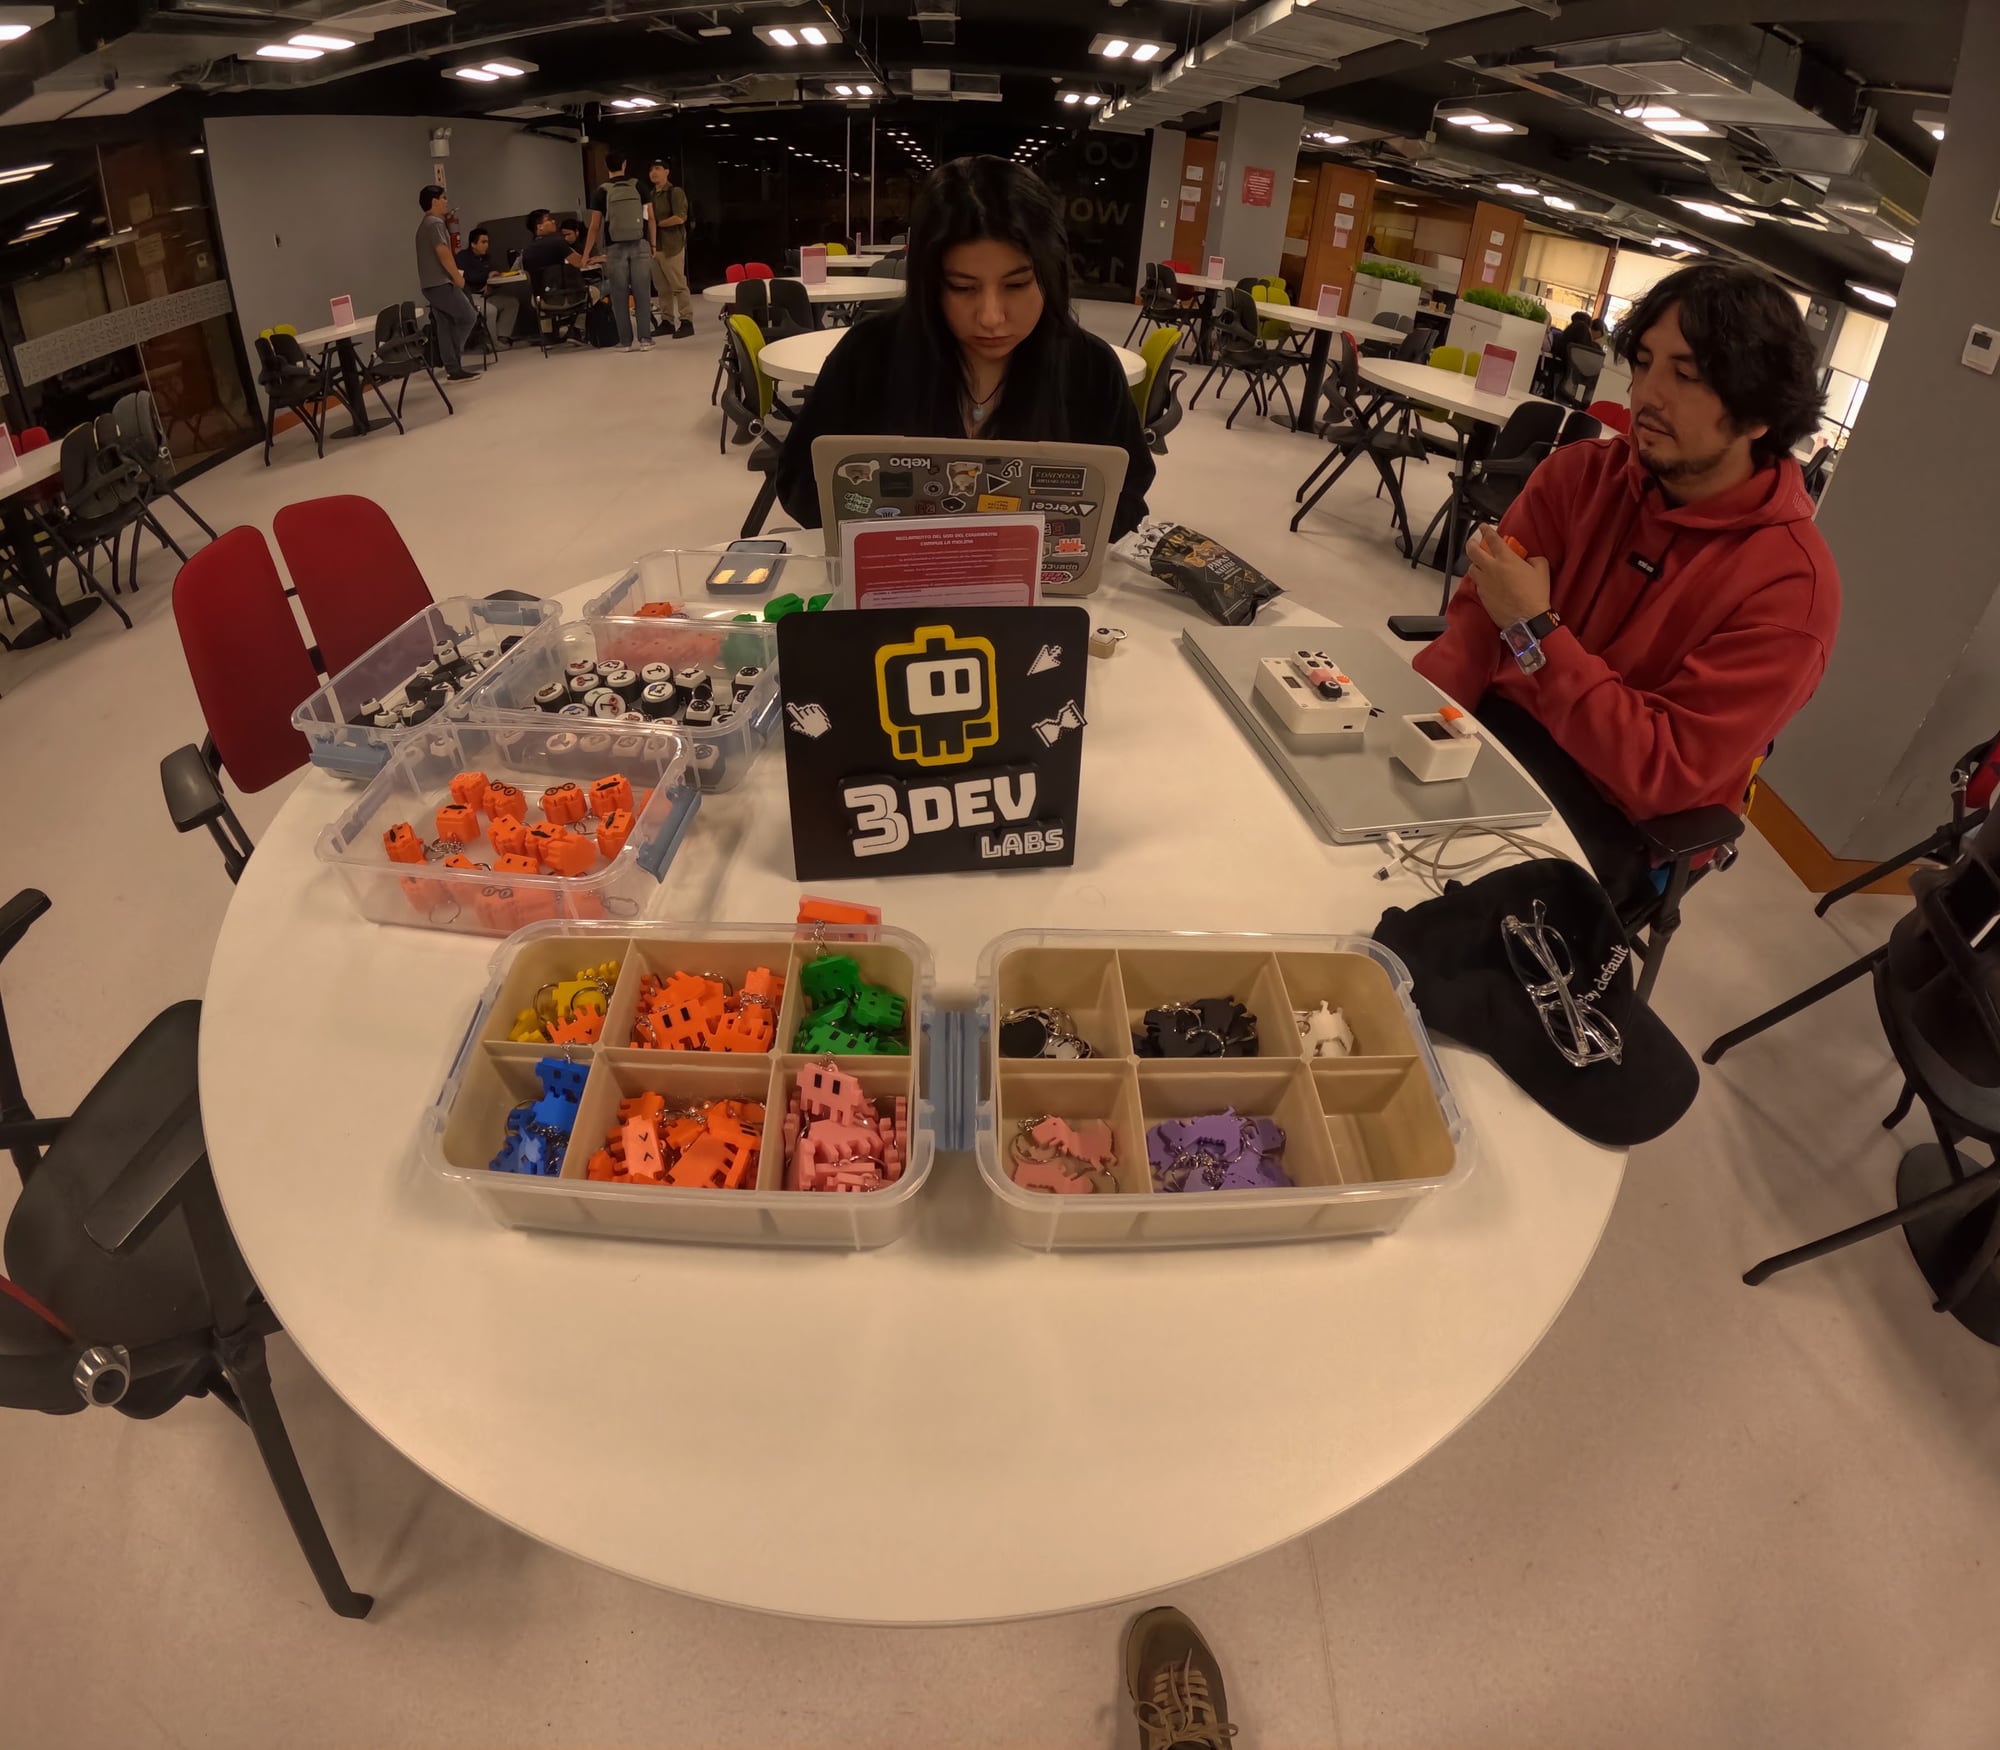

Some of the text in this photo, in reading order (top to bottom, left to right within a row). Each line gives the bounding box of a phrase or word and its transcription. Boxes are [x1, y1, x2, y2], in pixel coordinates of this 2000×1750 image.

[889, 457, 931, 469] kebo
[1031, 502, 1078, 515] Vercel
[1207, 555, 1231, 571] PAPAS
[843, 772, 1037, 858] 3DEV
[981, 828, 1065, 859] LABS
[1593, 944, 1629, 991] default
